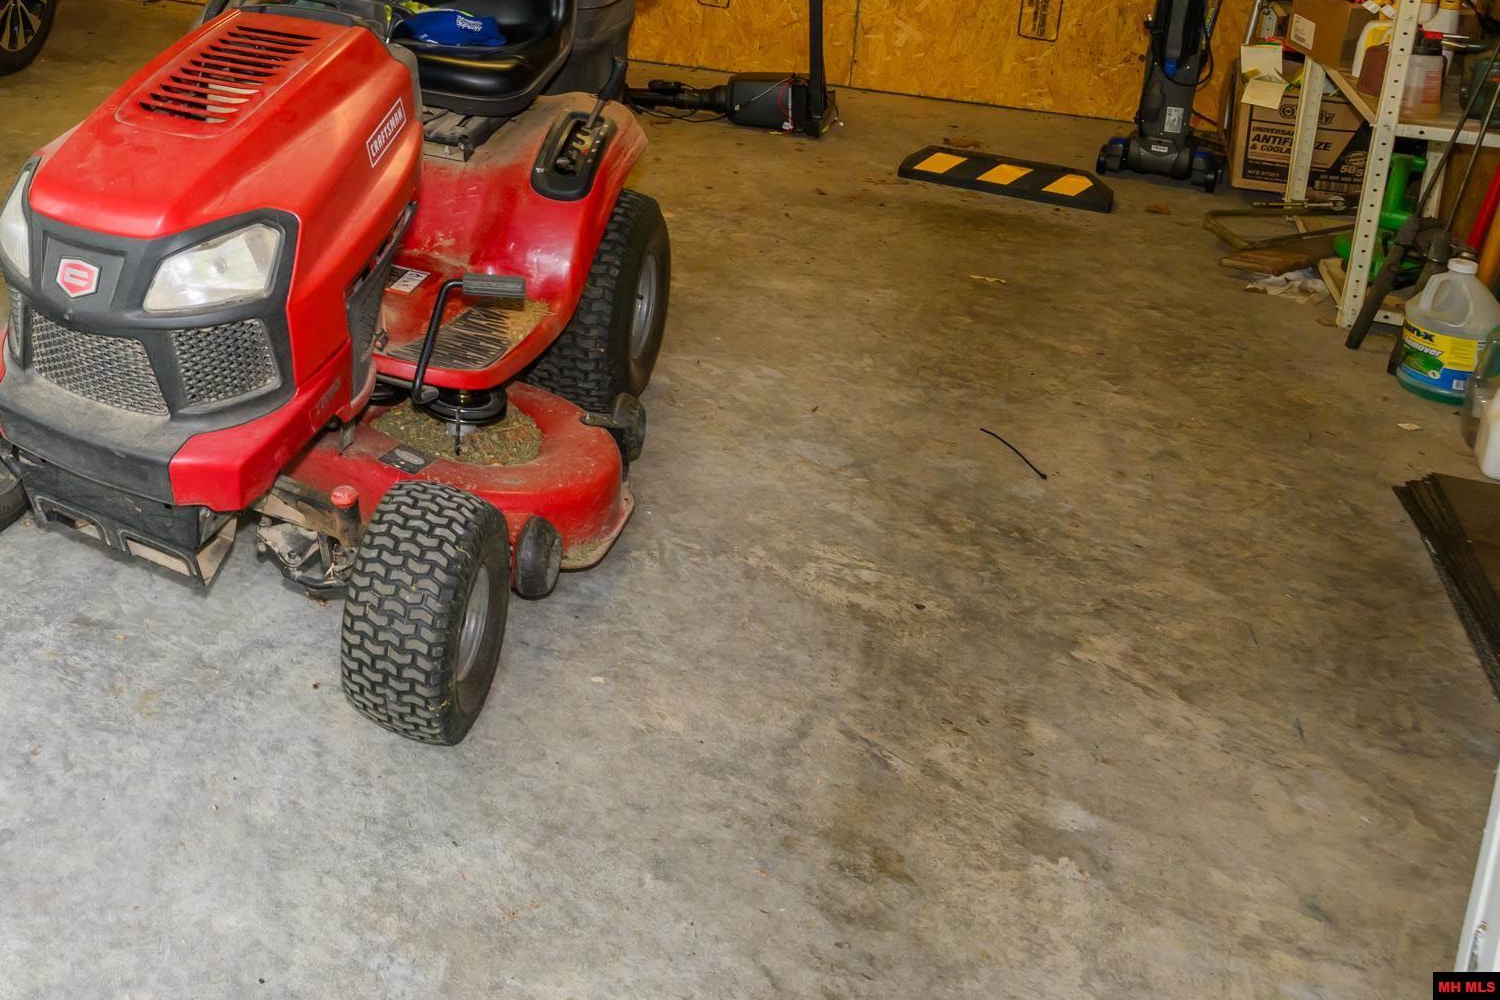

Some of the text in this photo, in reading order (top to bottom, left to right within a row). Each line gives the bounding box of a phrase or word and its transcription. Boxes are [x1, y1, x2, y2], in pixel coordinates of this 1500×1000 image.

[370, 107, 403, 157] CRAFTSMAN
[1252, 125, 1295, 136] UNIVERSA
[1250, 143, 1292, 153] & COOLA
[1251, 133, 1332, 151] ANTIFZE
